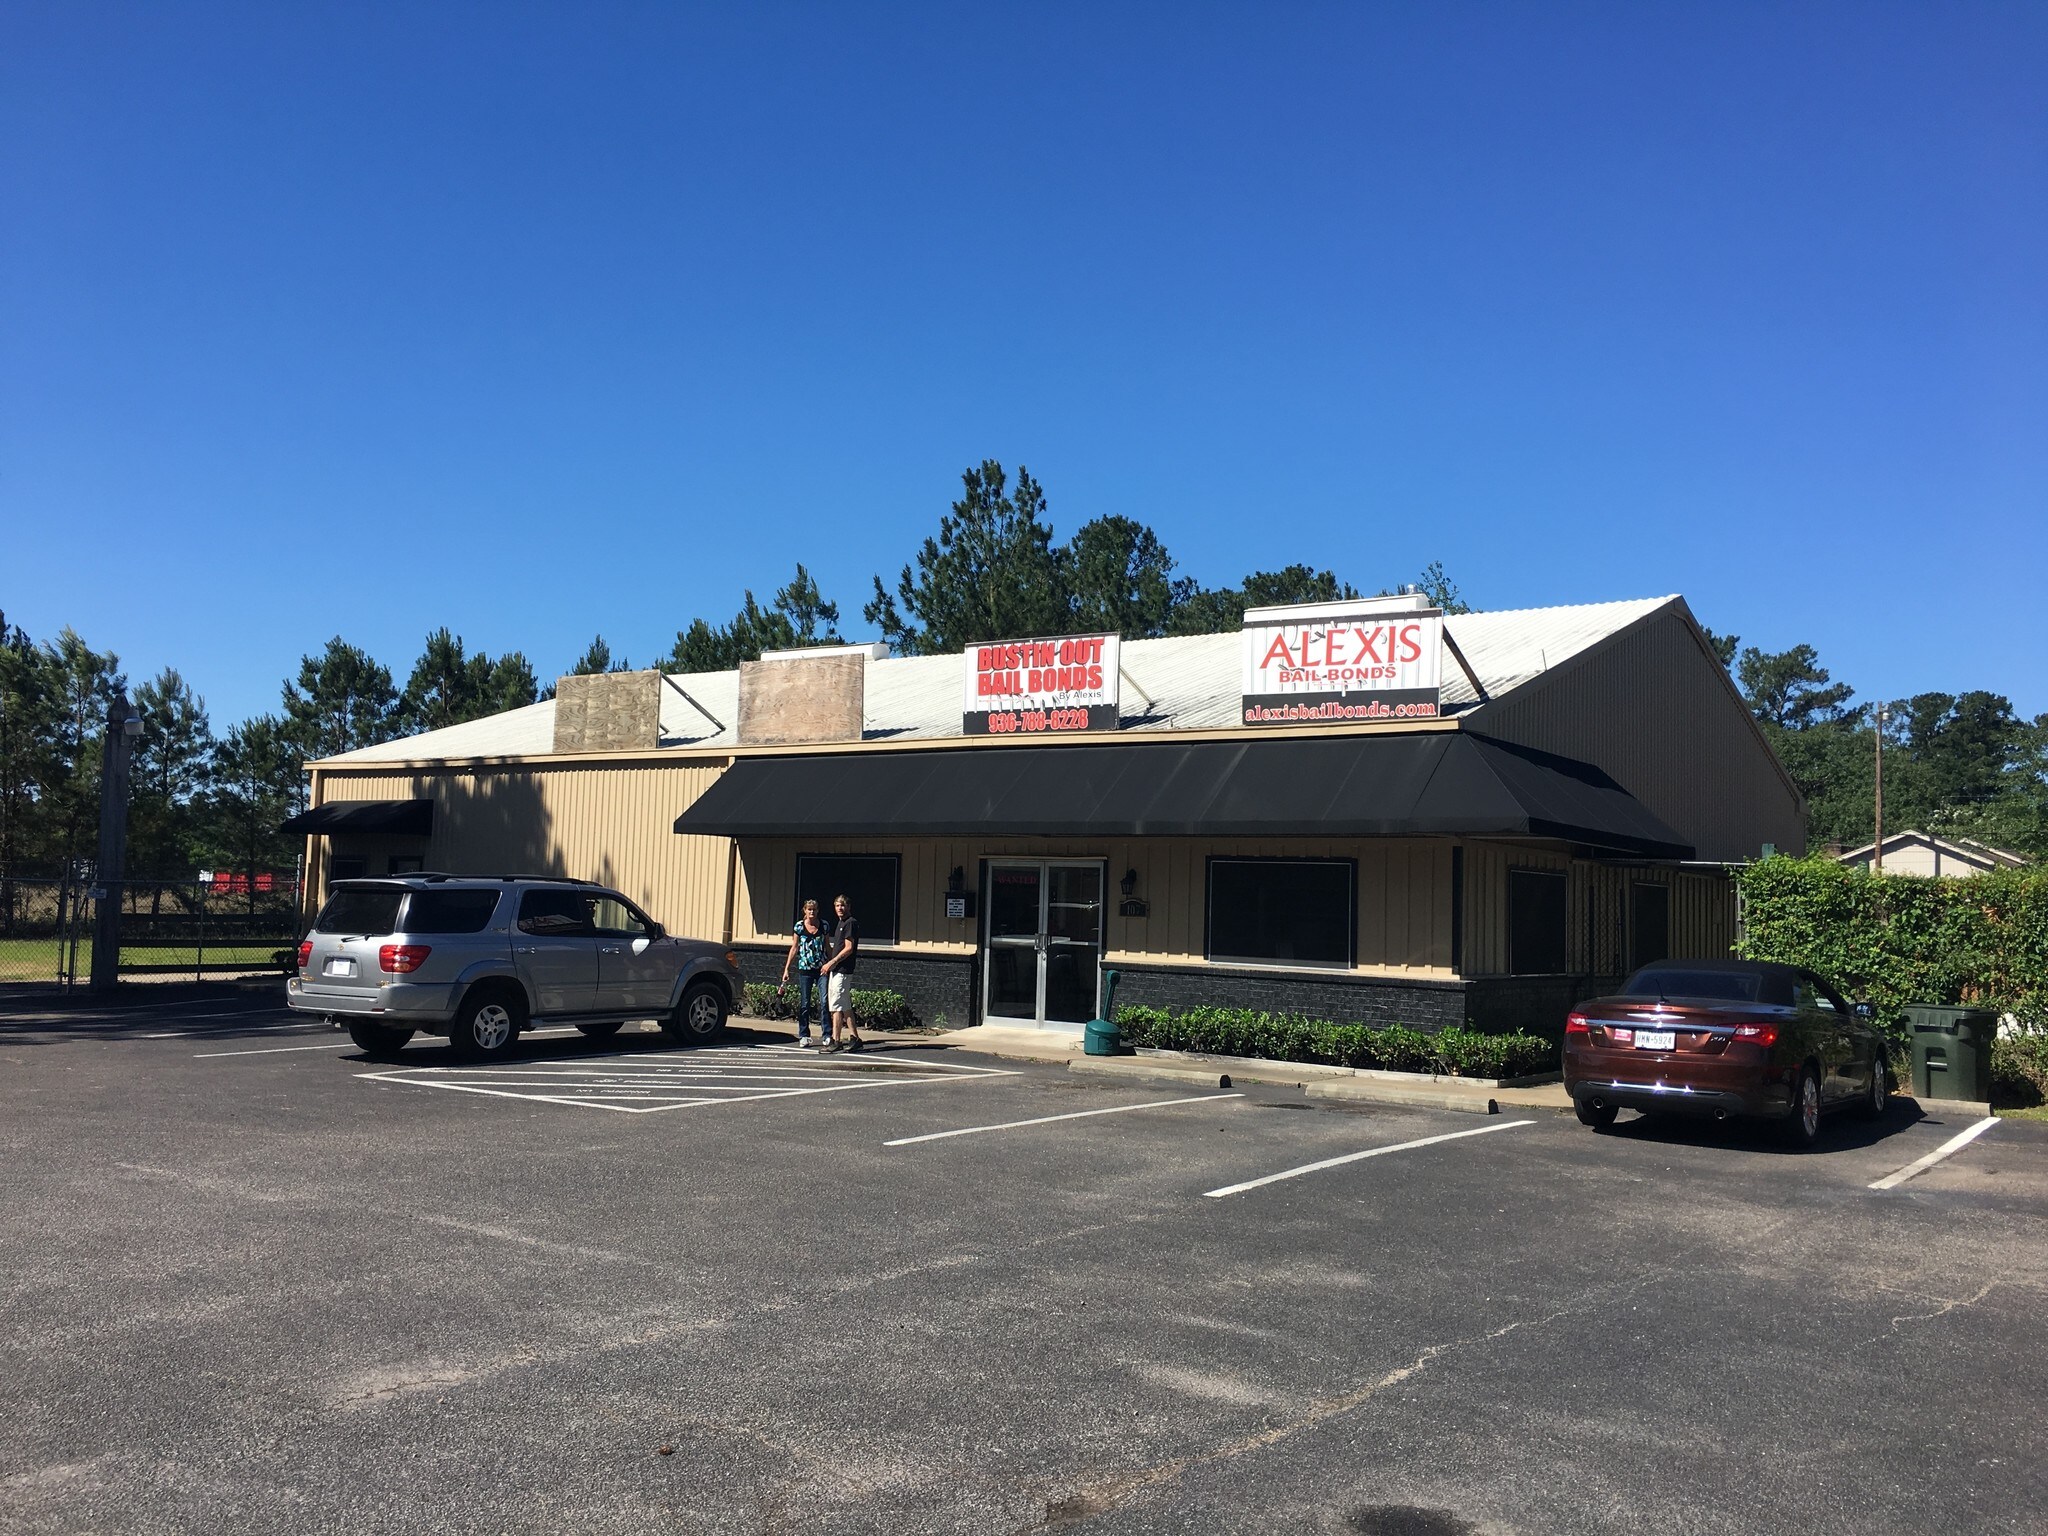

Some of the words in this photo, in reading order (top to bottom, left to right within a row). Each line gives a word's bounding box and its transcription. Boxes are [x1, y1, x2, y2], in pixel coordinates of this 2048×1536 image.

[977, 642, 1055, 672] BUSTIN
[1060, 637, 1105, 666] OUT
[1259, 624, 1422, 669] ALEXIS
[978, 671, 1024, 696] BAIL
[1028, 665, 1103, 693] BONDS
[1279, 669, 1321, 683] BAIL
[1328, 666, 1396, 680] BONDS
[1059, 691, 1071, 701] By
[1073, 690, 1102, 699] Alexis
[988, 708, 1089, 733] 936-788-8228
[1245, 700, 1436, 722] alexisbailbonds.com
